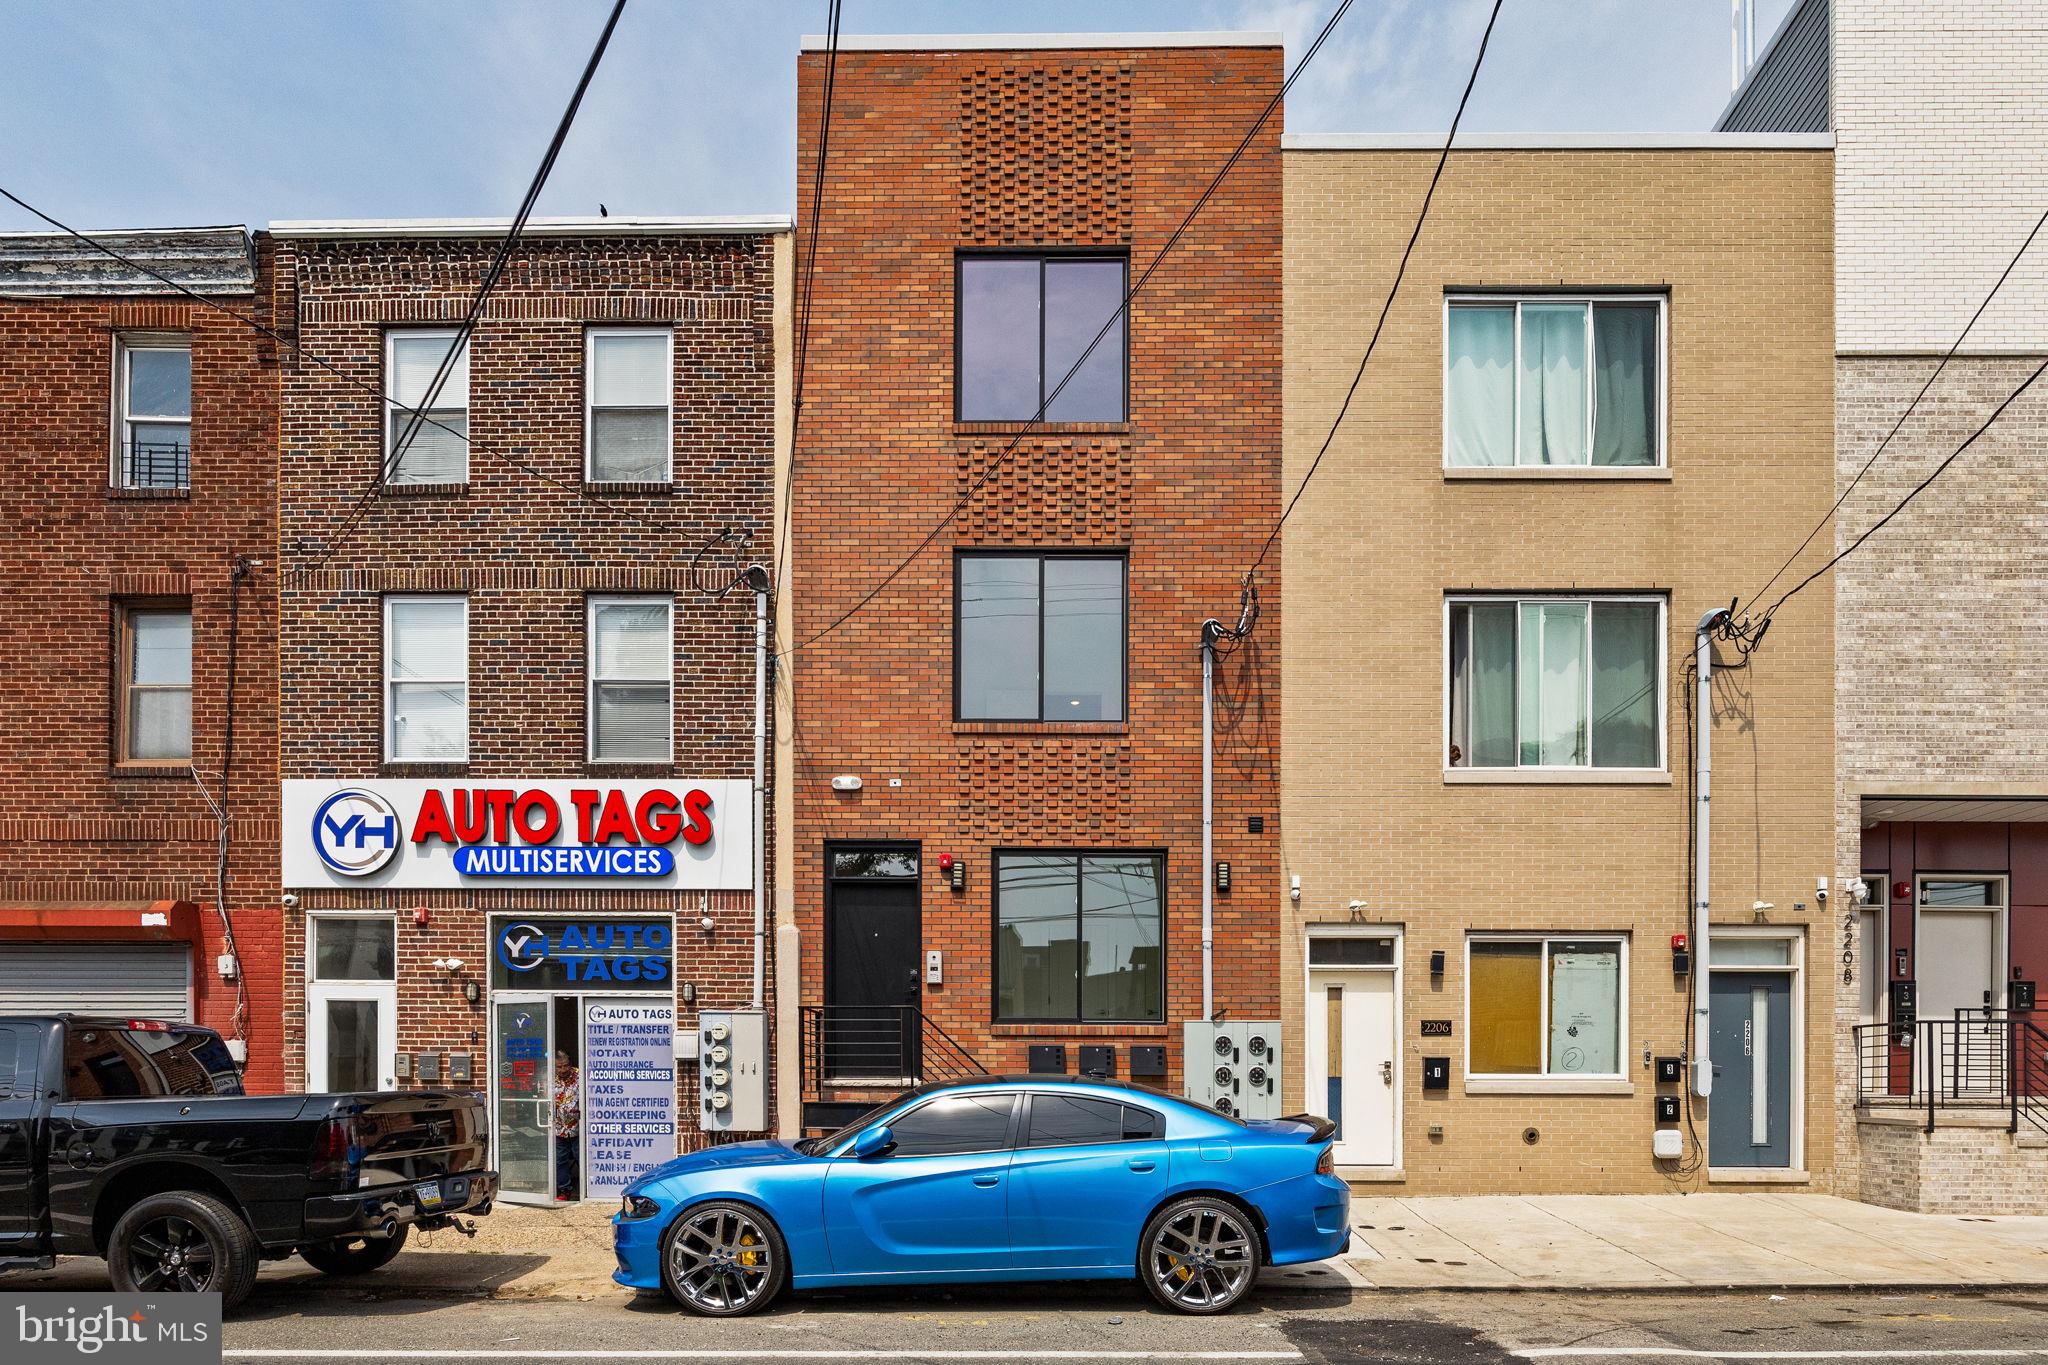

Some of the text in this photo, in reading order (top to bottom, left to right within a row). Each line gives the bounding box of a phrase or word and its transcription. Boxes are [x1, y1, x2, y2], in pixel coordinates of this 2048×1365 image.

[410, 788, 714, 845] AUTO TAGS
[324, 815, 395, 849] YH
[466, 848, 662, 875] MULTISERVICES
[559, 925, 671, 950] AUTO
[504, 935, 549, 958] YH
[1843, 914, 1853, 984] 2208
[559, 955, 667, 982] TAGS
[608, 1009, 639, 1019] AUTO
[643, 1009, 672, 1019] TAGS
[587, 1025, 614, 1035] TITLE
[621, 1025, 670, 1035] TRANSFER
[1424, 1022, 1449, 1033] 2206
[608, 1038, 649, 1047] REGISTRATION
[650, 1038, 671, 1047] ONLINE
[588, 1061, 609, 1069] AUTO
[589, 1070, 671, 1080] ACCOUNTING SERVICES
[588, 1085, 624, 1094] TAXES
[588, 1097, 670, 1107] ITIN AGENT CERTIFIED
[589, 1110, 667, 1120] BOOKKEEPING
[590, 1124, 671, 1133] OTHER SERVICES
[591, 1138, 654, 1147] AFFIDAVIT
[592, 1150, 632, 1160] EASE
[593, 1163, 626, 1172] PANISH
